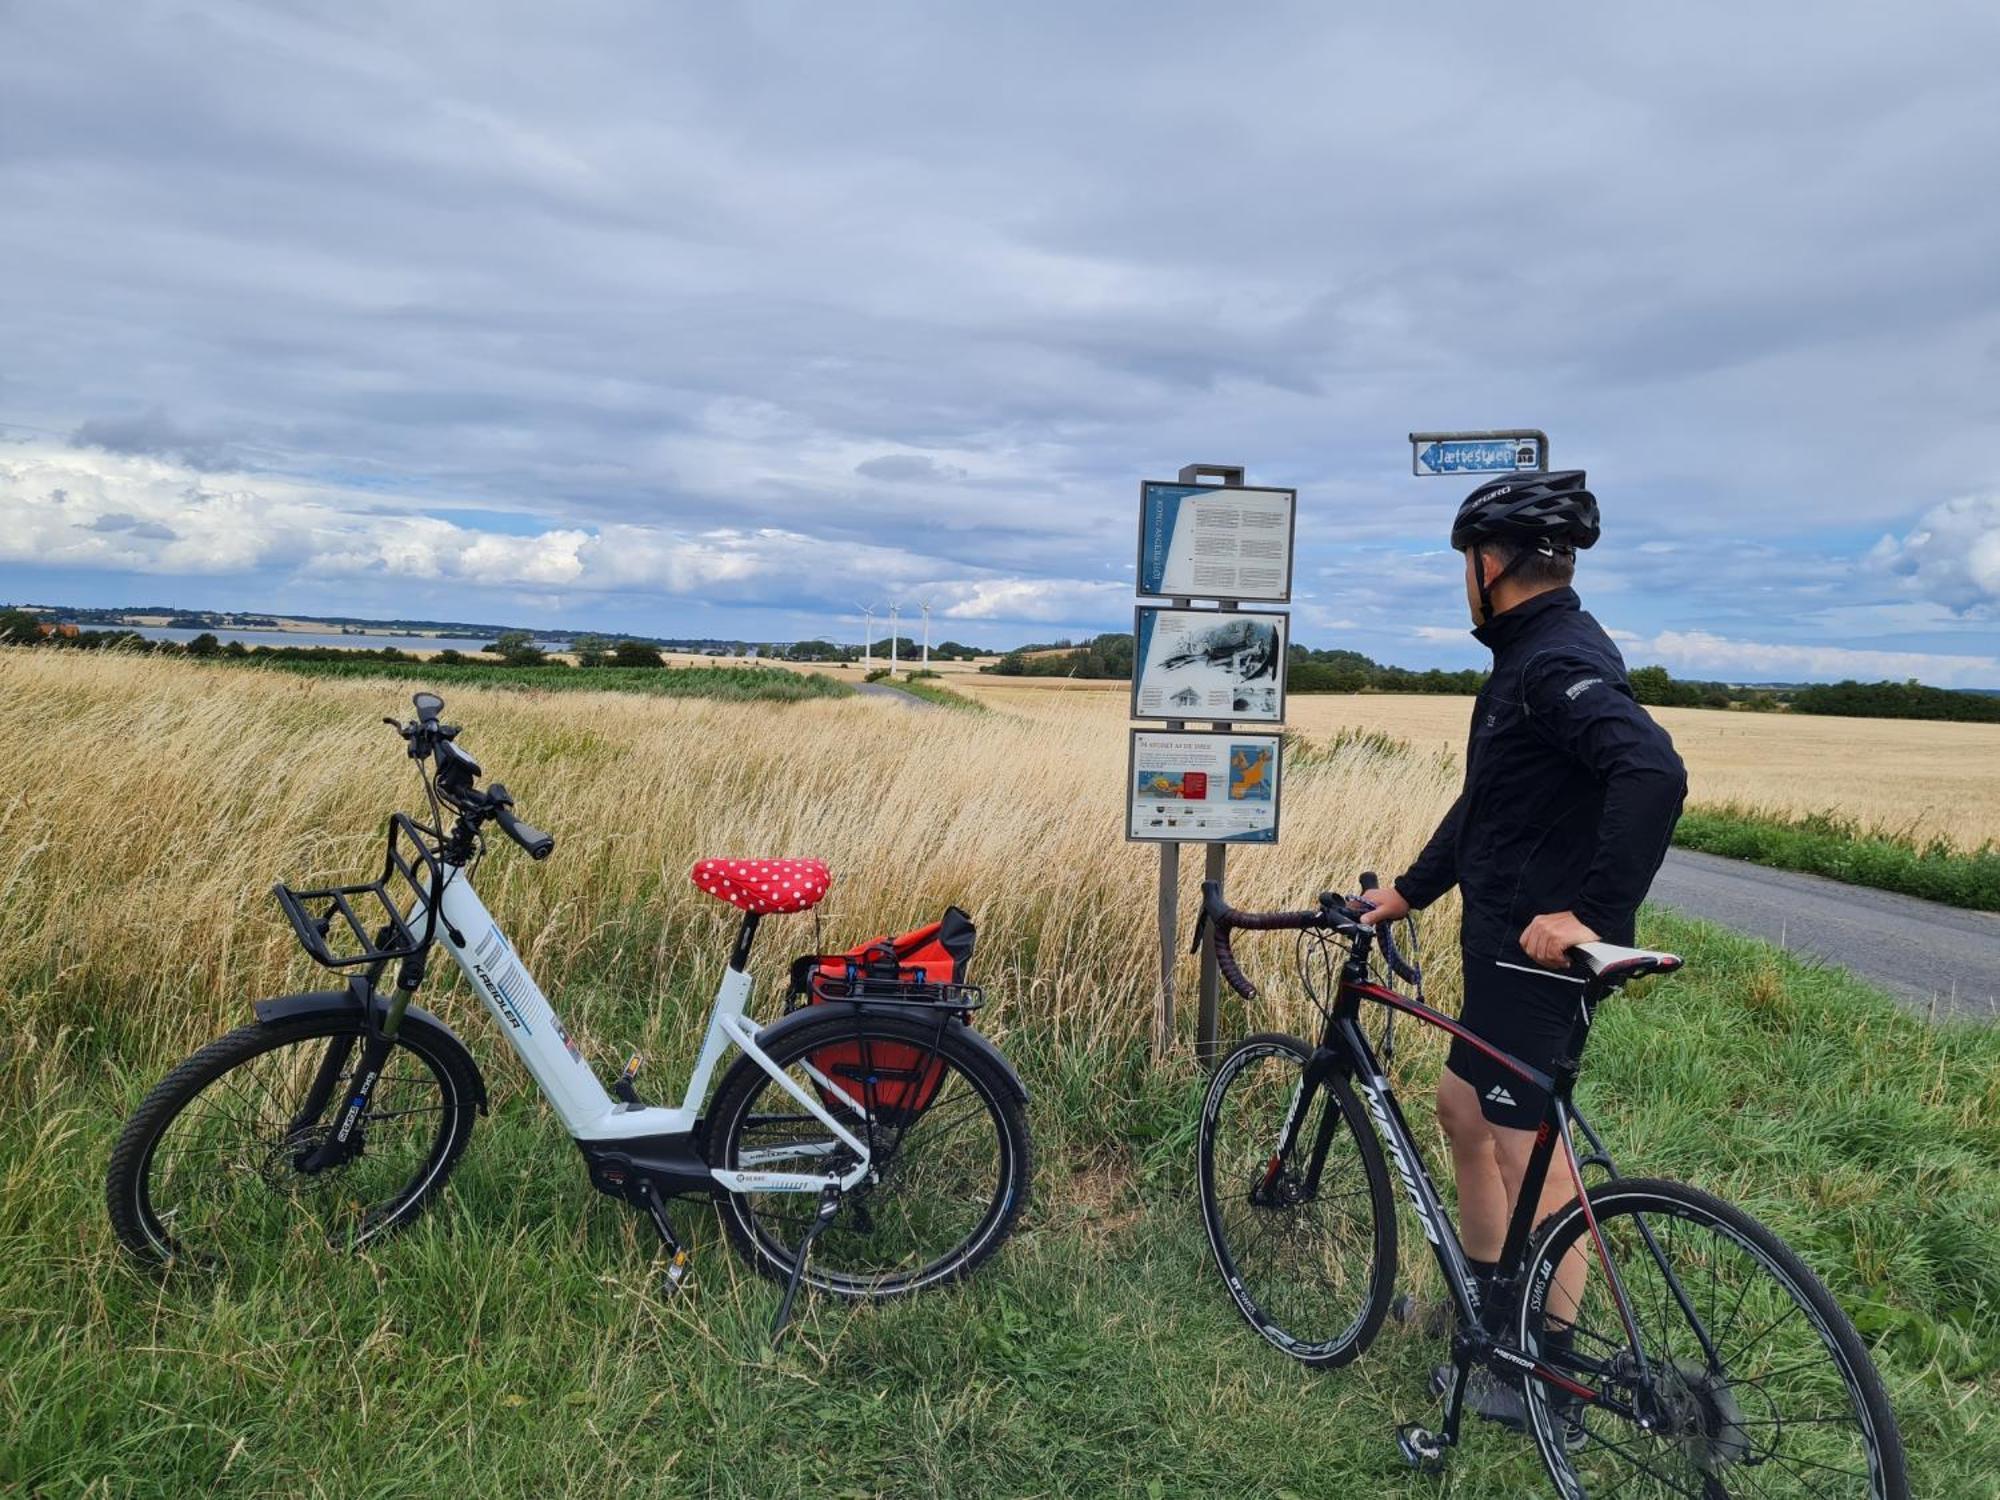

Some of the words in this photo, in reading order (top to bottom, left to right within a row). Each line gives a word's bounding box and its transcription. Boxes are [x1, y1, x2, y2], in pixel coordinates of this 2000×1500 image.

[1438, 447, 1512, 465] Jættestuen
[473, 964, 521, 1029] KREIDLER
[1361, 1083, 1440, 1245] MERIDA
[1540, 1259, 1553, 1280] DT
[1230, 1276, 1242, 1291] DT
[1239, 1291, 1256, 1315] SWISS
[1530, 1277, 1546, 1313] SWISS
[1493, 1347, 1535, 1370] MERIDA
